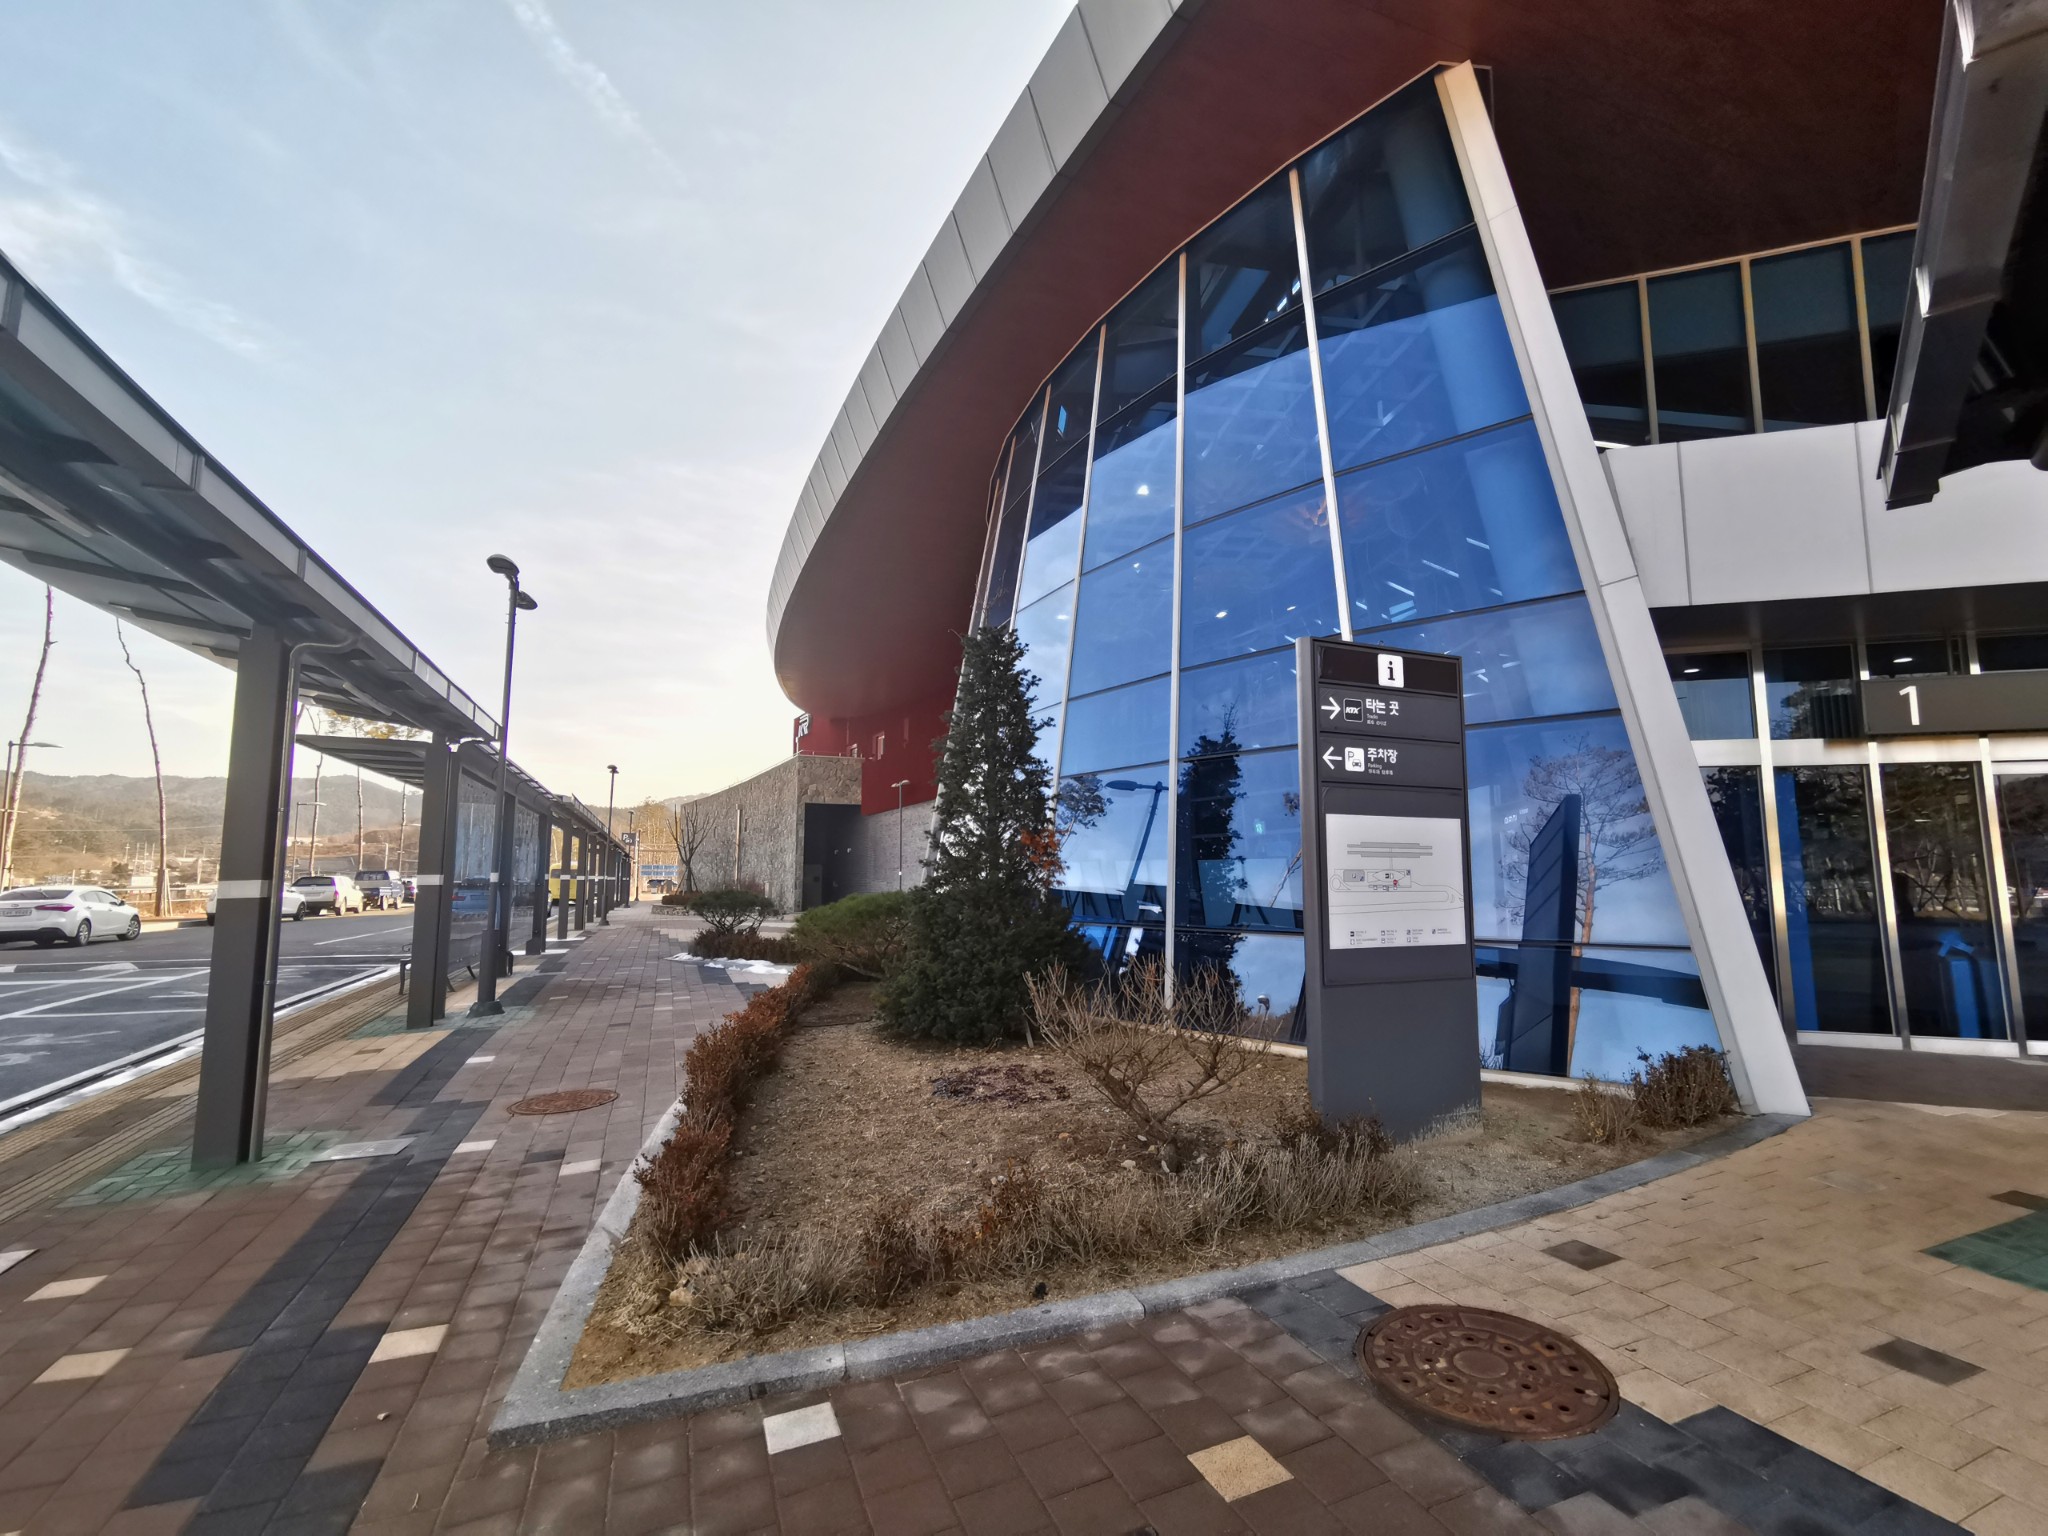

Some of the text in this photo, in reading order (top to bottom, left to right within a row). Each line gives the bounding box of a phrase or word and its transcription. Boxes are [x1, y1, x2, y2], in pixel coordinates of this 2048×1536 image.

[1346, 706, 1360, 714] KTX
[1365, 698, 1399, 716] 타는 곳
[1898, 685, 1920, 726] 1
[1367, 747, 1398, 764] 주차장
